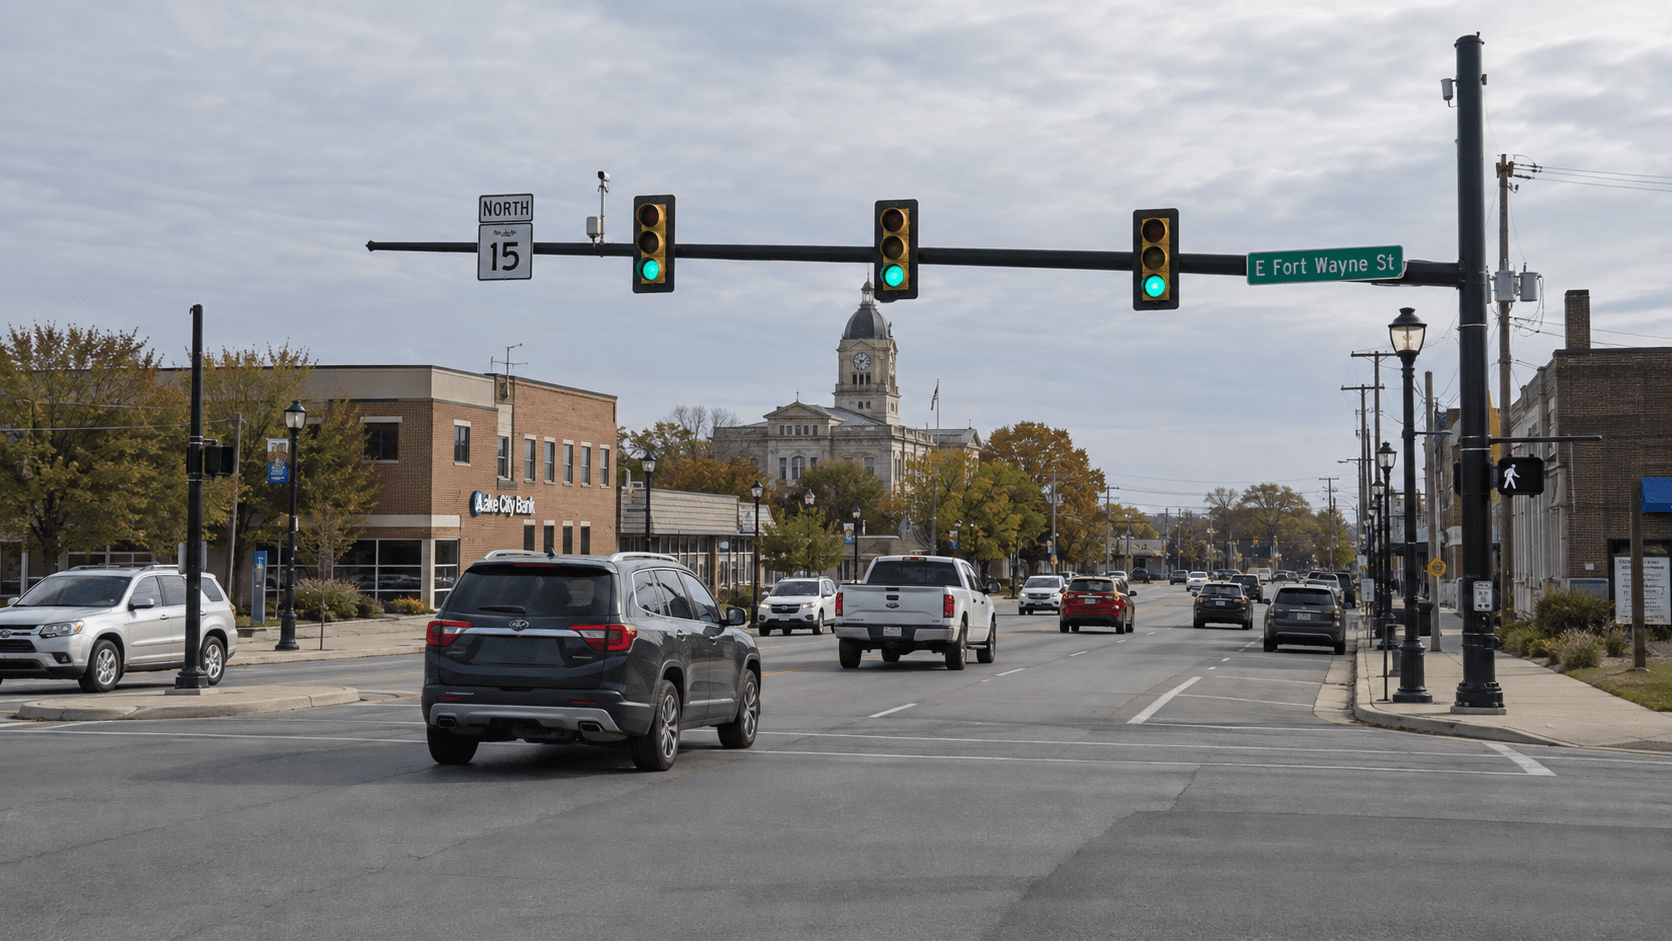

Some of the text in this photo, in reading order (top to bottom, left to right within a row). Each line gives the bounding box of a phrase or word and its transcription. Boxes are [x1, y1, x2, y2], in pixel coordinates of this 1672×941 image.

[483, 200, 529, 217] NORTH
[490, 241, 520, 272] 15
[1255, 253, 1395, 277] E Fort Wayne St
[500, 494, 516, 517] City
[516, 495, 536, 514] Bank
